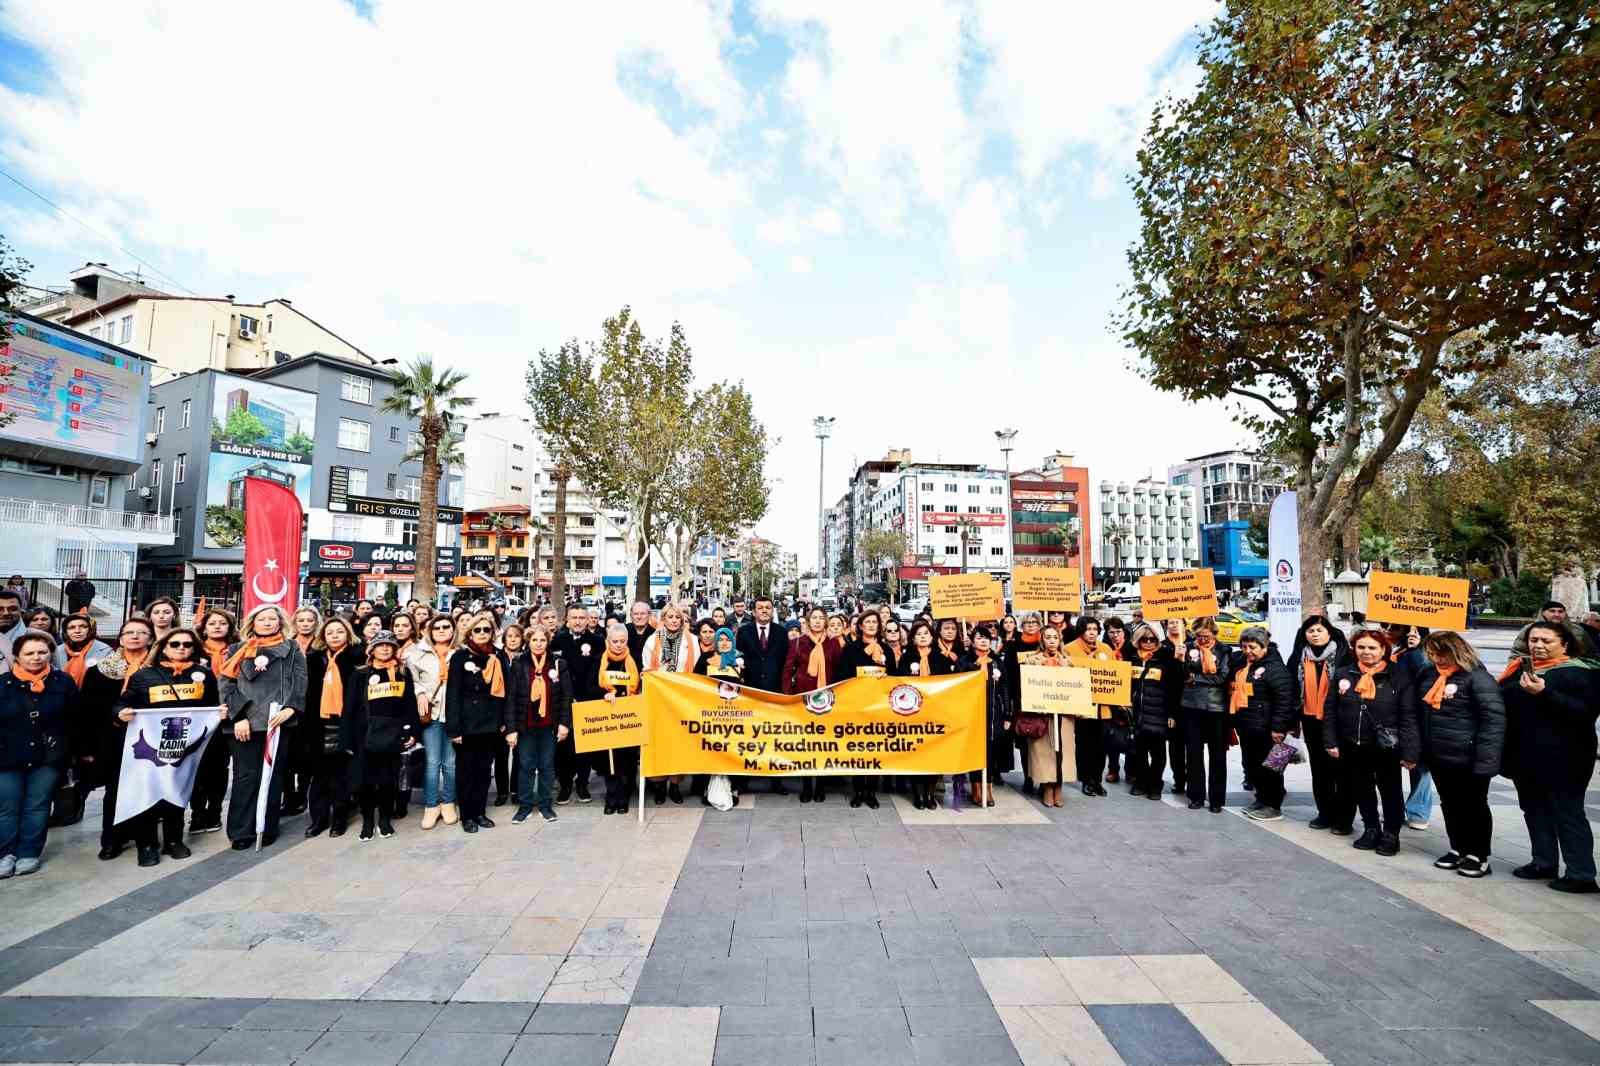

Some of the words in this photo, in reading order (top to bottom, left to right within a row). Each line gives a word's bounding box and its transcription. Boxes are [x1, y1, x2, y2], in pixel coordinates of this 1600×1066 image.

[220, 444, 251, 455] SAĞLIK
[252, 447, 270, 458] İÇİN
[271, 451, 287, 460] HER
[287, 453, 303, 463] ŞEY
[355, 503, 385, 514] IRIS
[324, 547, 351, 557] Torku
[1410, 588, 1451, 599] kadının
[1412, 596, 1464, 609] toplumun
[1027, 678, 1053, 688] Mutlu
[1056, 678, 1085, 689] olmak
[162, 687, 195, 696] DUYGU
[581, 726, 604, 736] Şiddet
[680, 720, 745, 739] "Dünya
[751, 721, 826, 739] yüzünde
[833, 721, 945, 739] gördüğümüz
[159, 740, 186, 749] KADIN
[701, 738, 729, 753] her
[737, 740, 767, 756] şey
[774, 738, 839, 752] kadının
[846, 738, 924, 753] eseridir."
[744, 758, 762, 770] M.
[768, 758, 817, 771] Kemal
[824, 758, 882, 770] Atatürk
